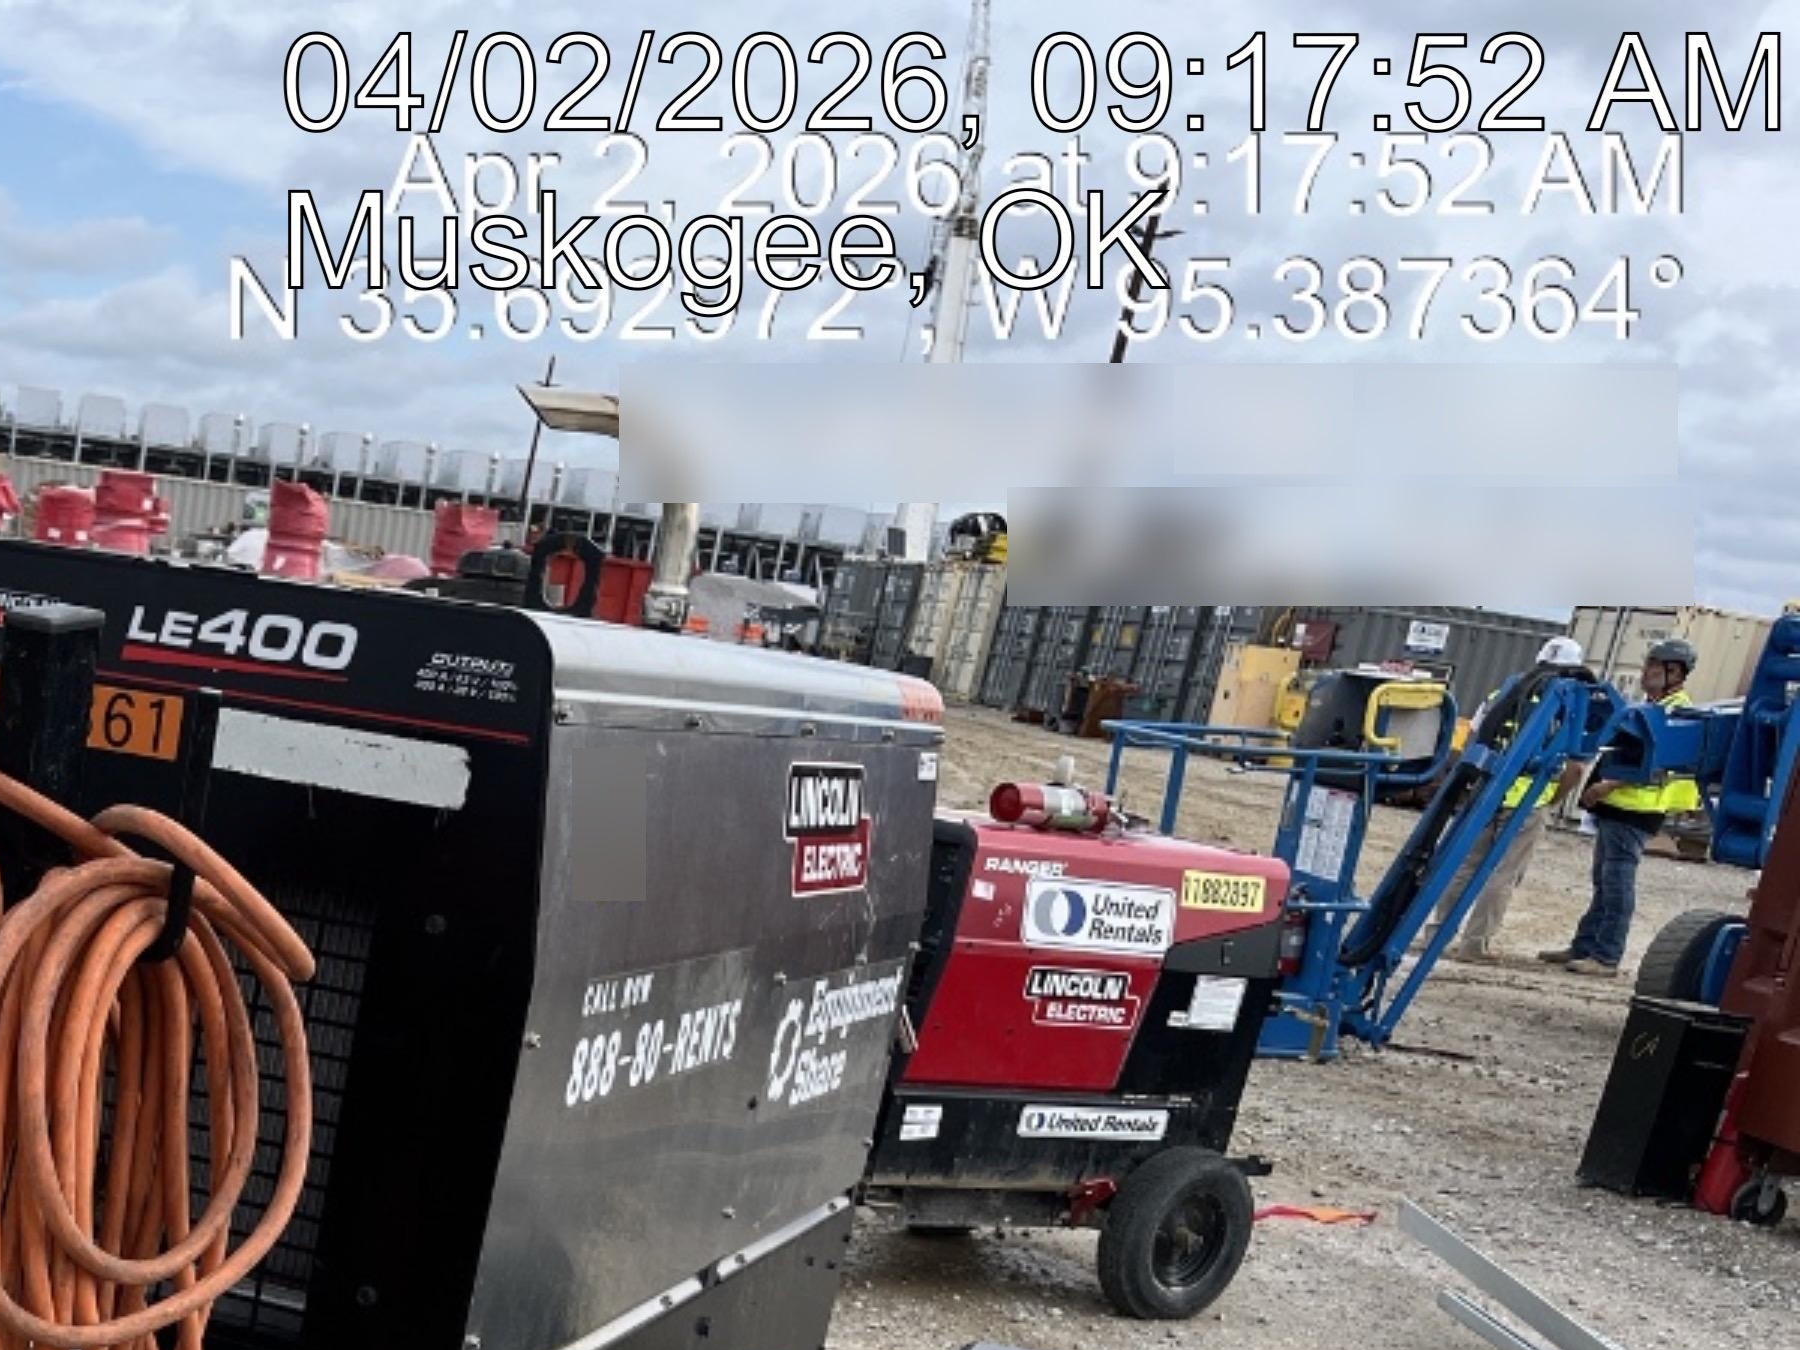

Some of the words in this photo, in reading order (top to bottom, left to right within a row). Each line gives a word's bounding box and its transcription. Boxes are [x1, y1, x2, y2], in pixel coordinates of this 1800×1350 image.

[126, 605, 358, 670] LE400
[788, 776, 862, 828] LINCOLN
[801, 842, 862, 883] ELECTRIC
[984, 857, 1065, 877] RANGER
[1091, 893, 1162, 922] United
[1088, 917, 1163, 946] Rentals
[1030, 971, 1123, 1000] LINCOLN
[805, 966, 904, 1046] Equipment
[1046, 1001, 1127, 1025] ELECTRIC
[788, 1047, 848, 1108] Share
[1047, 1112, 1101, 1133] United
[1101, 1114, 1159, 1134] Rentals
